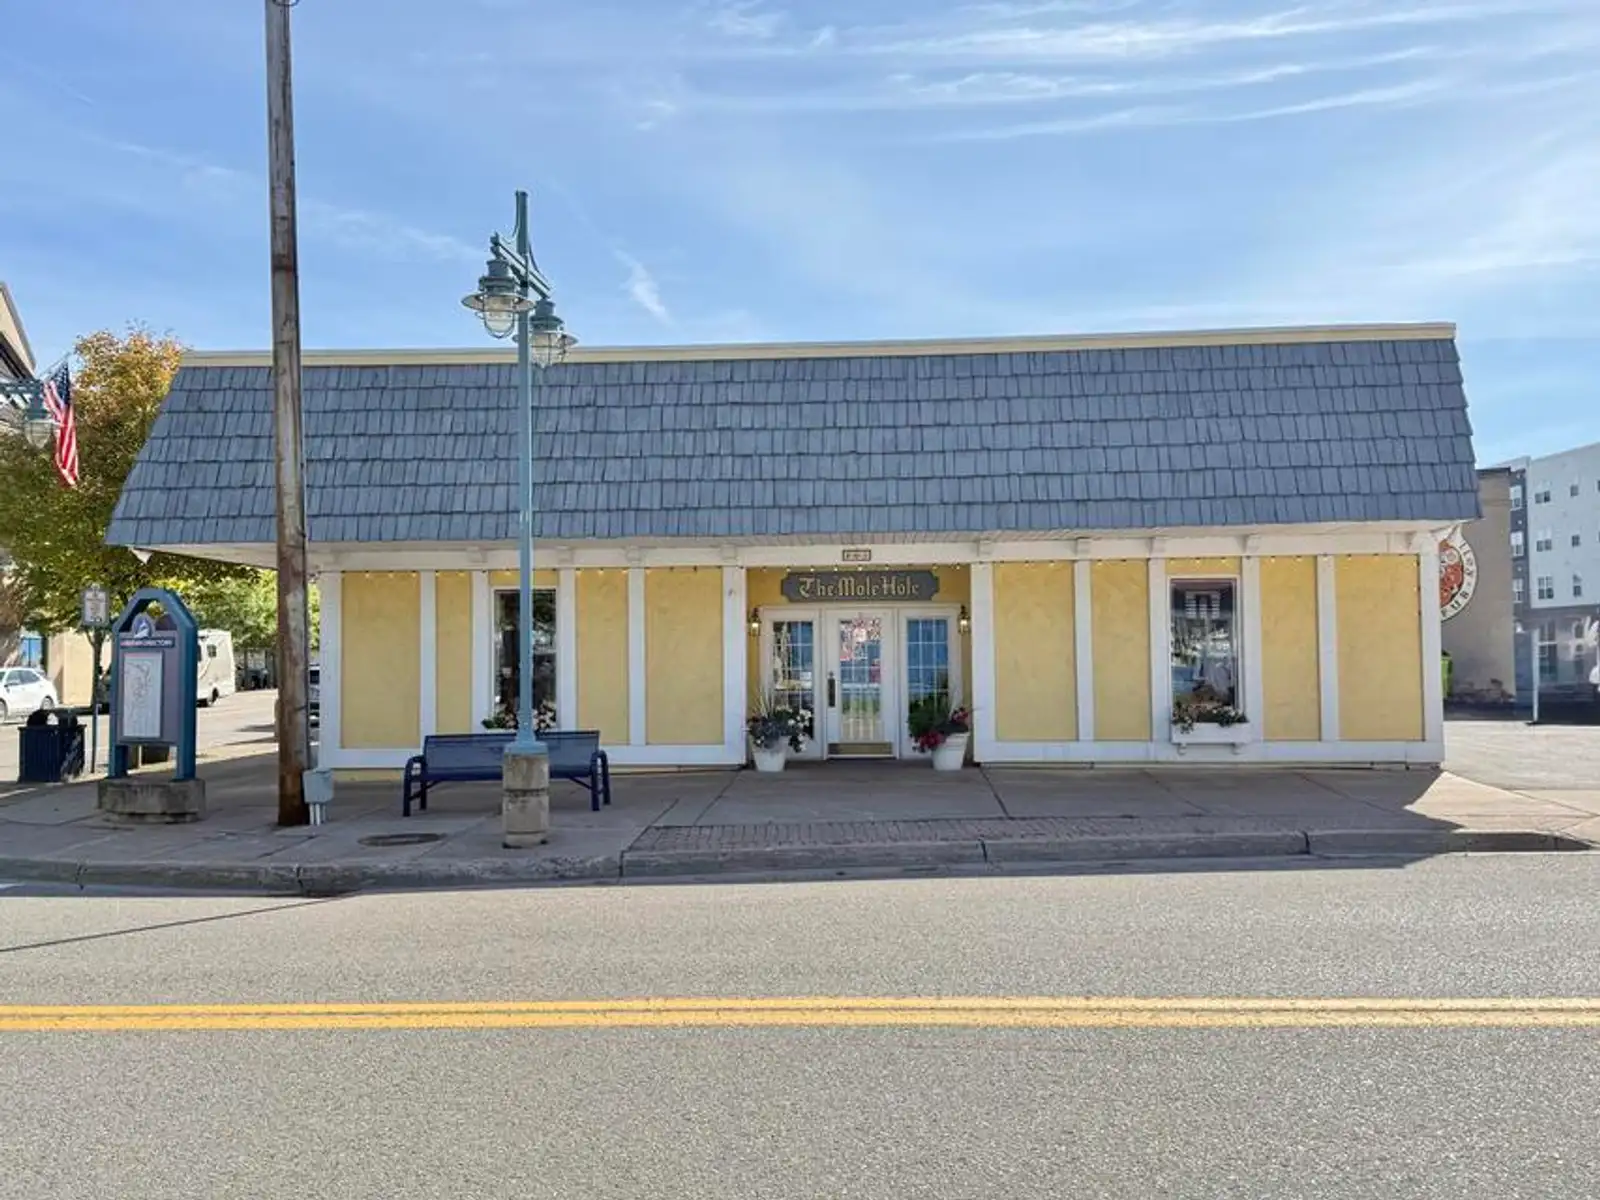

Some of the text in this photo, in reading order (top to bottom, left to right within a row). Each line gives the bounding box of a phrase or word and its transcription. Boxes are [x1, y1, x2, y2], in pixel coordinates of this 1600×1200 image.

[799, 575, 920, 598] The Mole Hole
